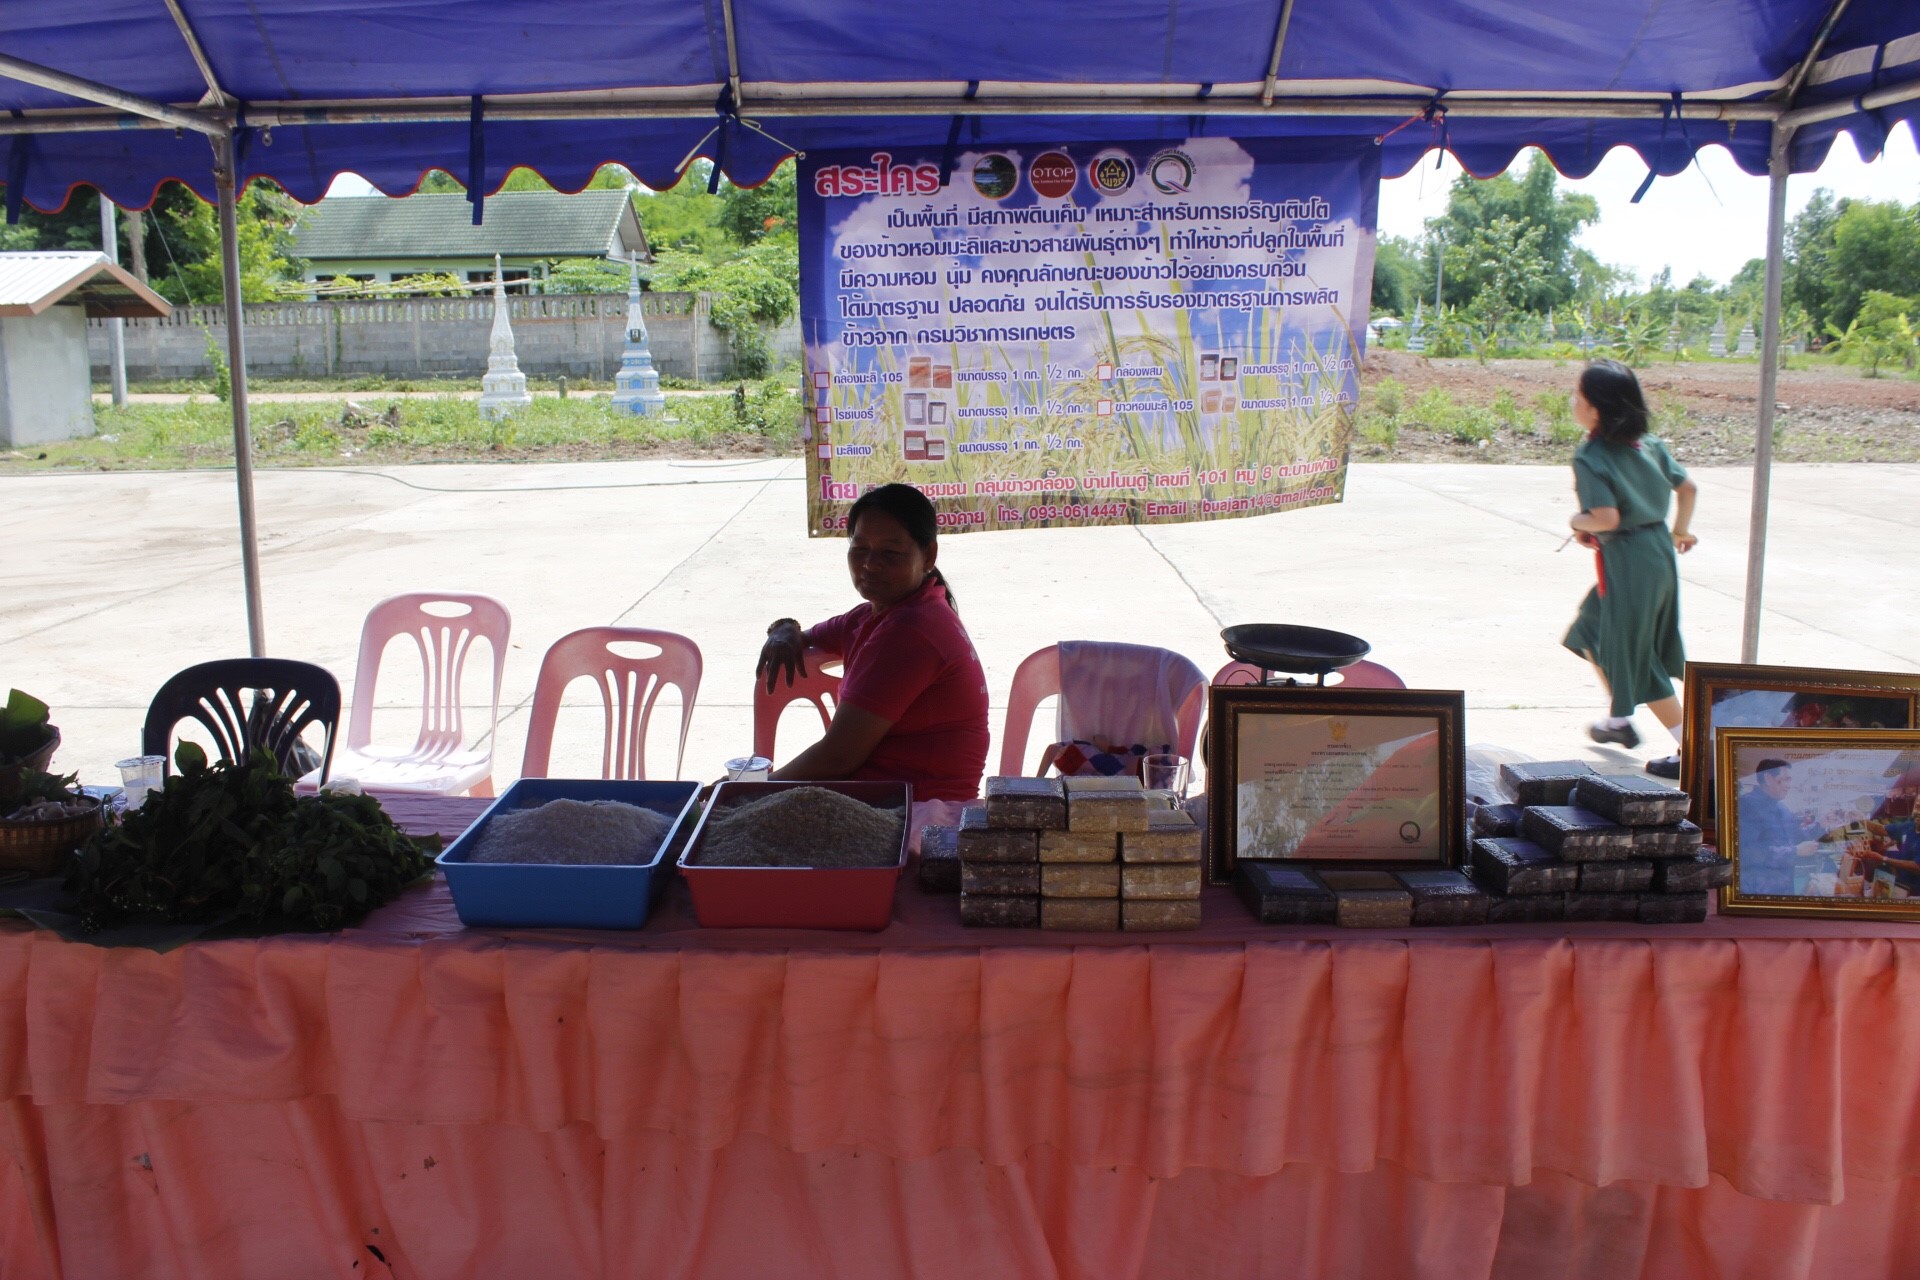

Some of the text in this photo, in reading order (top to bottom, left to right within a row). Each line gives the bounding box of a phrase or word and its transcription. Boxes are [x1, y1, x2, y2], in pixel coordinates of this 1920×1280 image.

[816, 152, 940, 197] สระใคร
[1032, 167, 1074, 178] OTOP
[888, 197, 1329, 229] เป็นพื้นที่ มีสภาพดินเค็ม เหมาะสำหรับการเจริญเติบโต
[840, 225, 1345, 259] ของข้าวหอมมะลิและข้าวสายพันธุ์ต่างๆ ทำให้ข้าวที่ปลูกในพื้นที่
[840, 255, 1306, 290] มีความหอม นุ่ม คงคุณลักษณะของข้าวไว้อย่างครบถ้วน
[839, 288, 1339, 320] ได้มาตรฐาน ปลอดภัย จนได้รับการรับรองมาตรฐานการผลิต
[843, 323, 1076, 347] ข้าวจาก กรมวิชาการเกษตร
[833, 370, 877, 384] กล้องมะลิ
[882, 372, 903, 383] 105
[957, 370, 1007, 384] ขนาดบรรจุ
[1012, 370, 1019, 380] 1
[1023, 369, 1040, 380] กก.
[1067, 369, 1084, 379] กก.
[1115, 363, 1163, 377] กล้องผสม
[1242, 365, 1289, 376] ขนาดบรรจุ
[958, 405, 1008, 419] ขนาดบรรจุ
[1012, 406, 1019, 416] 1
[1023, 405, 1040, 416] กก.
[1067, 405, 1084, 414] กก.
[1172, 400, 1193, 411] 105
[1241, 399, 1287, 409] ขนาดบรรจุ
[836, 445, 872, 457] มะลิแดง
[958, 441, 1008, 454] ขนาดบรรจุ
[1012, 441, 1019, 450] 1
[1024, 441, 1040, 450] กก.
[1066, 440, 1084, 449] กก.
[820, 475, 858, 500] โดย
[974, 471, 1076, 496] กลุ่มข้าวกล้อง
[1083, 469, 1148, 491] บ้านโนนดู่
[1155, 467, 1190, 487] เลขที่
[1199, 470, 1227, 484] 101
[1235, 463, 1257, 485] หมู่
[1262, 466, 1272, 479] 8
[1278, 458, 1338, 477] ต.บ้านฝาง
[998, 505, 1023, 521] โทร.
[1029, 503, 1127, 520] 093-0614447
[1146, 501, 1187, 516] Email
[1202, 486, 1334, 513] buajan14@gmail.com
